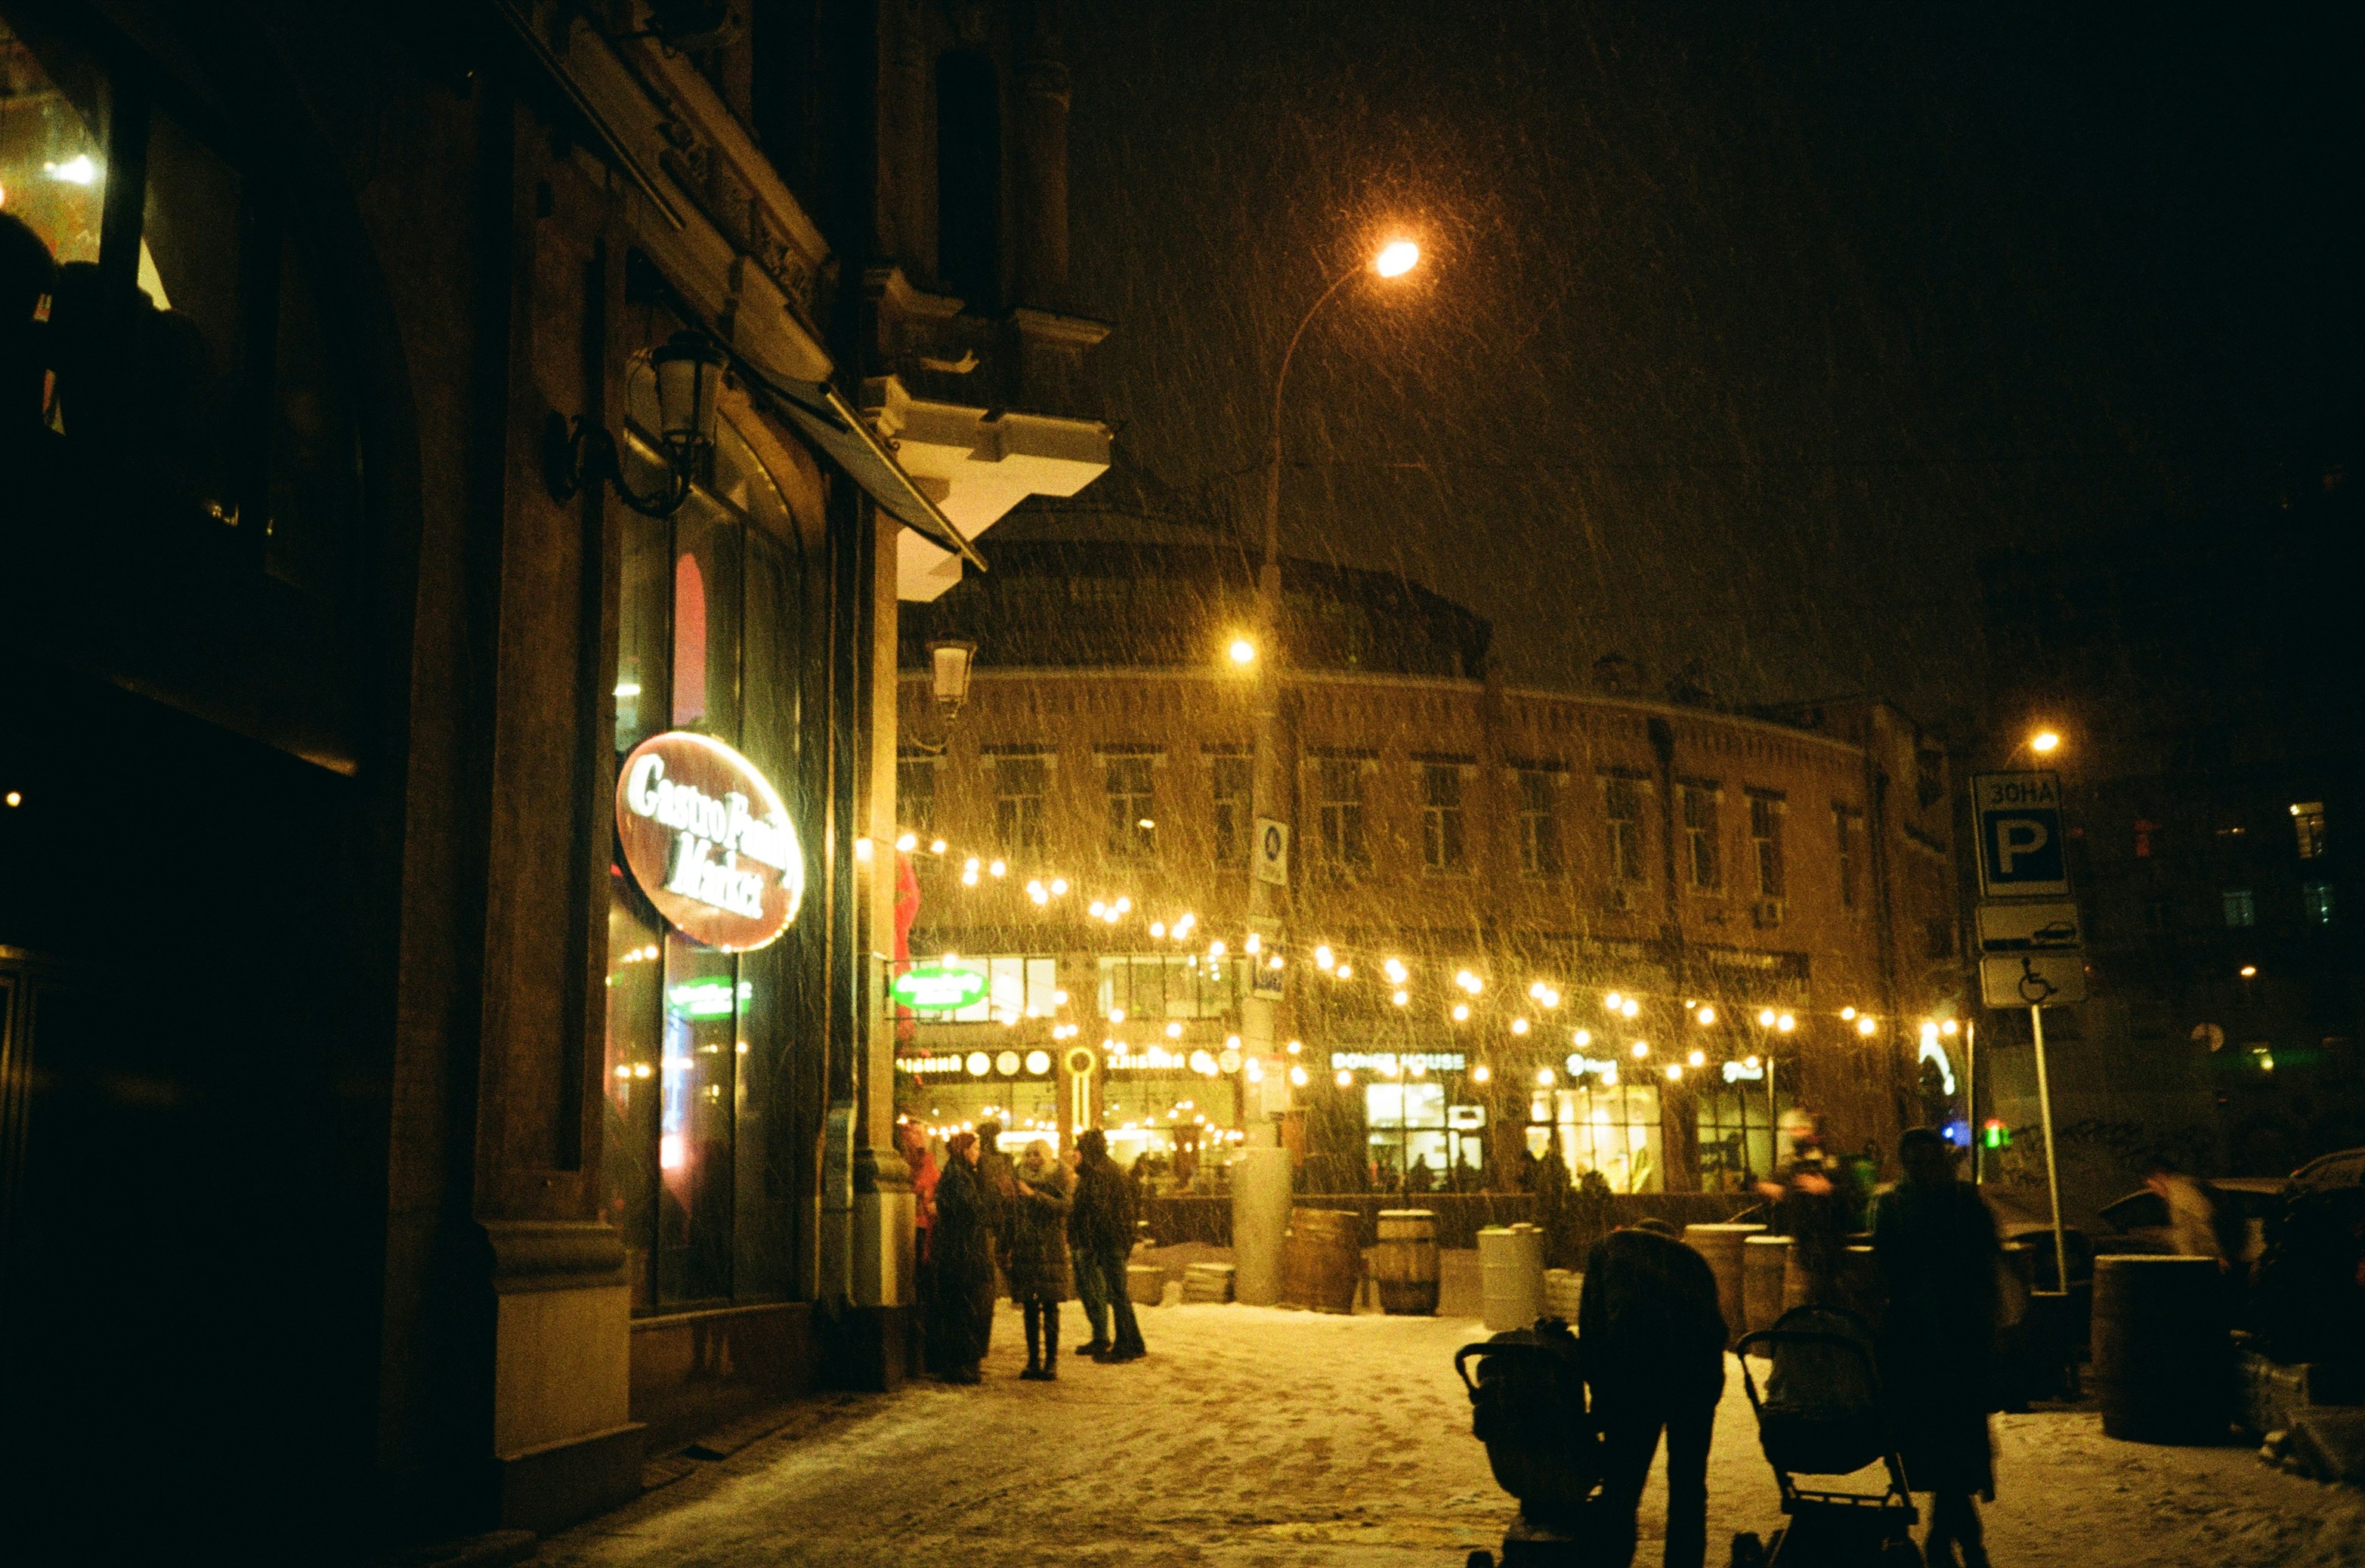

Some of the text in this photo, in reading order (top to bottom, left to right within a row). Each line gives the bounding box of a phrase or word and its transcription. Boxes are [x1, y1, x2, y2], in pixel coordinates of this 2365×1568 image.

[628, 753, 727, 843] Gastro
[1992, 781, 2055, 805] ЗОНА
[1996, 818, 2048, 874] P
[1400, 1053, 1465, 1070] HOUSE
